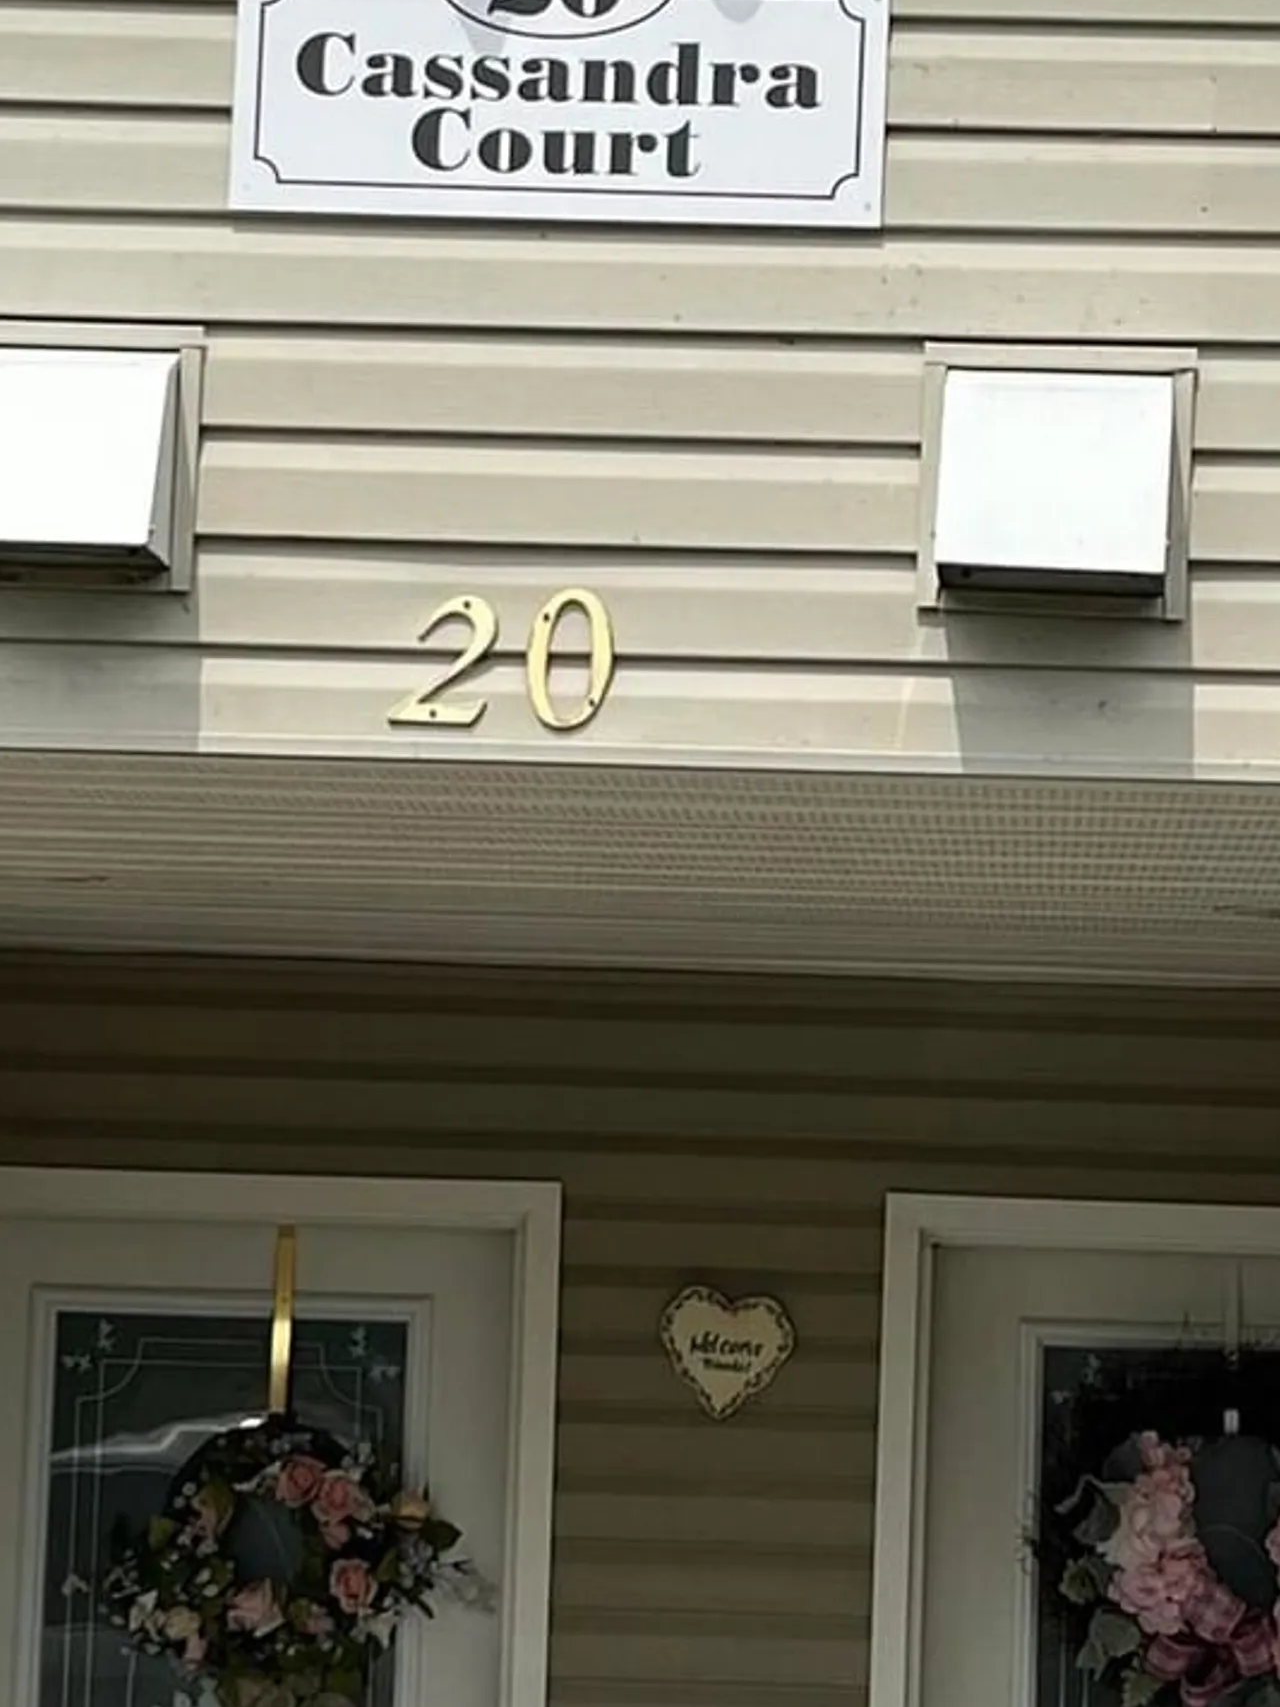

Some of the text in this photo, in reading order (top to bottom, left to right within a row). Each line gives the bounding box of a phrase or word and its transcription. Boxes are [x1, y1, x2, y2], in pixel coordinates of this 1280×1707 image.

[296, 32, 822, 109] Cassandra
[412, 107, 701, 178] Court
[388, 588, 615, 731] 20
